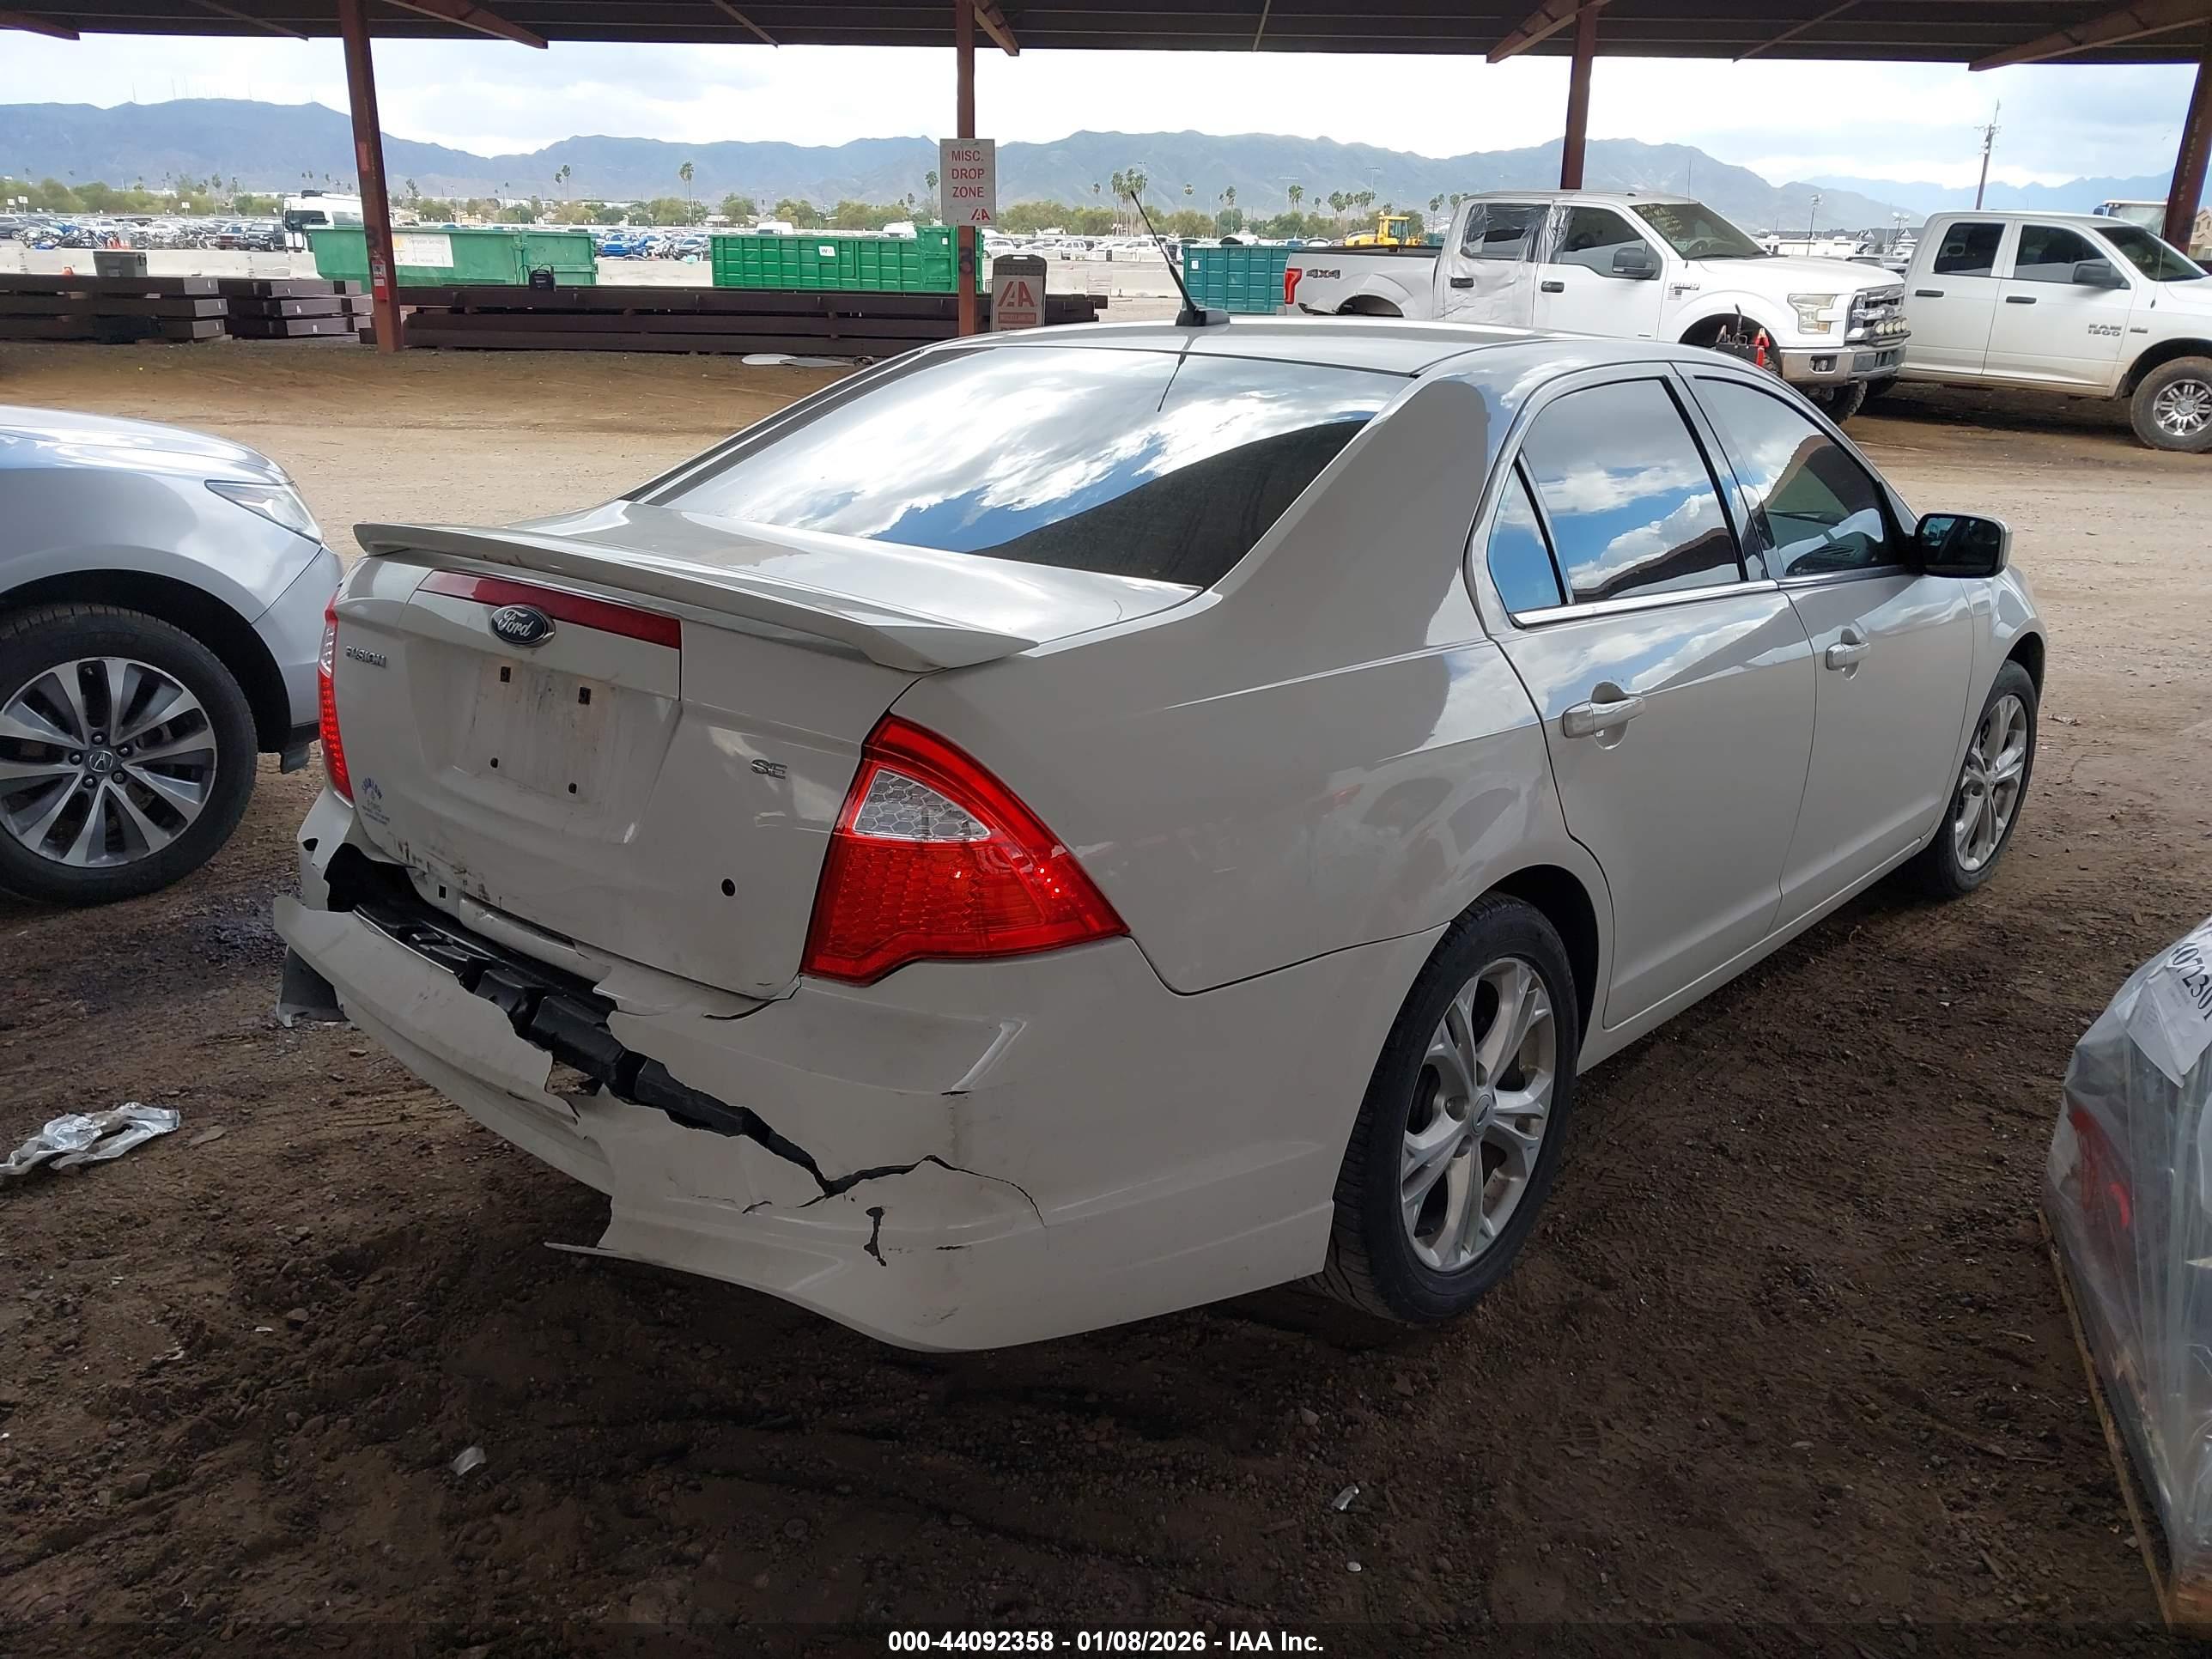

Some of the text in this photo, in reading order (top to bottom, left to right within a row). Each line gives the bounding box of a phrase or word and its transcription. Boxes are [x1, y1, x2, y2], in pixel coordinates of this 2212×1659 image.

[951, 150, 984, 161] MISC.
[951, 168, 985, 179] DROP
[952, 186, 985, 198] ZONE
[497, 609, 535, 637] Ford
[345, 645, 386, 667] FUSION
[751, 759, 787, 780] SE
